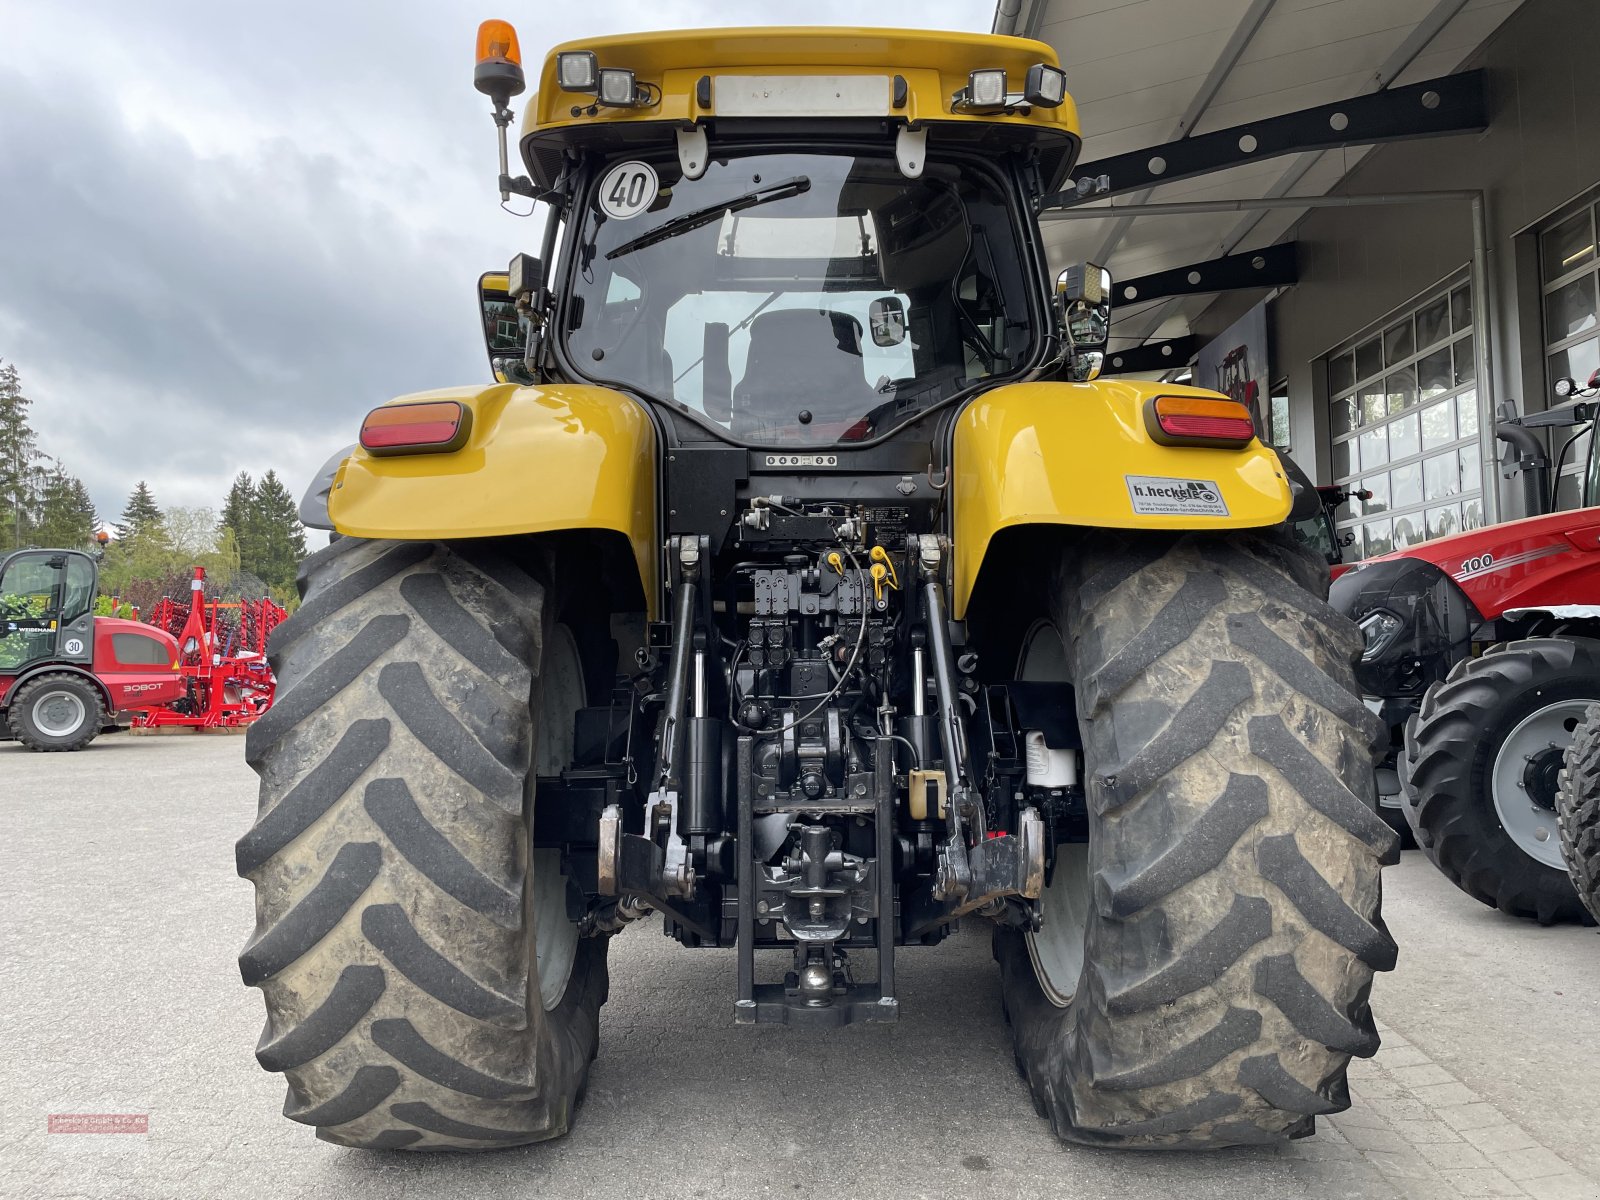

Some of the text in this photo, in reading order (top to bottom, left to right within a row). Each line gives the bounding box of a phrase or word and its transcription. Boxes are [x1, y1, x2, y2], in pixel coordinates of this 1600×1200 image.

[608, 172, 647, 208] 40
[1134, 486, 1200, 500] h.heckele
[1461, 554, 1494, 574] 100
[69, 642, 80, 652] 30
